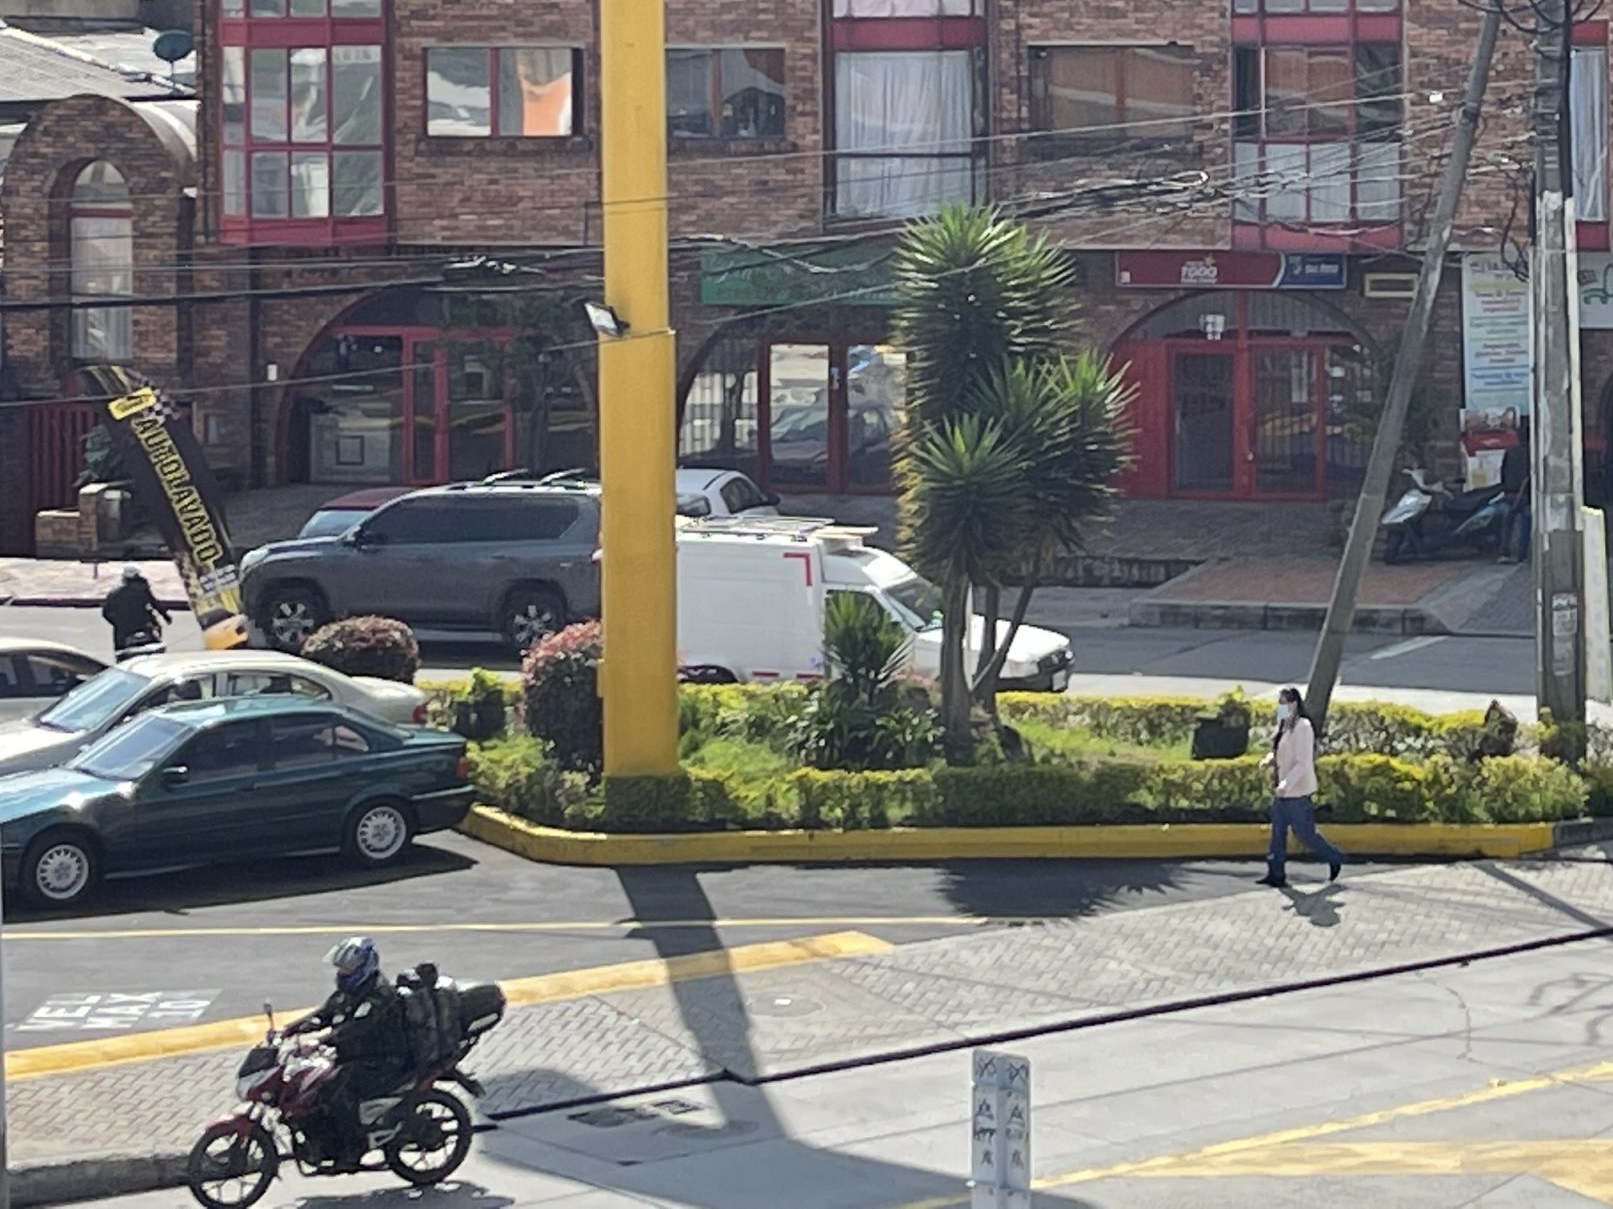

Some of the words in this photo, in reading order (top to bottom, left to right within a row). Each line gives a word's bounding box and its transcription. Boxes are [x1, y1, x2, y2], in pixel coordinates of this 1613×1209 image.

[131, 416, 222, 565] AUTOLAVADO
[14, 994, 102, 1032] VEL
[80, 991, 163, 1030] MAX
